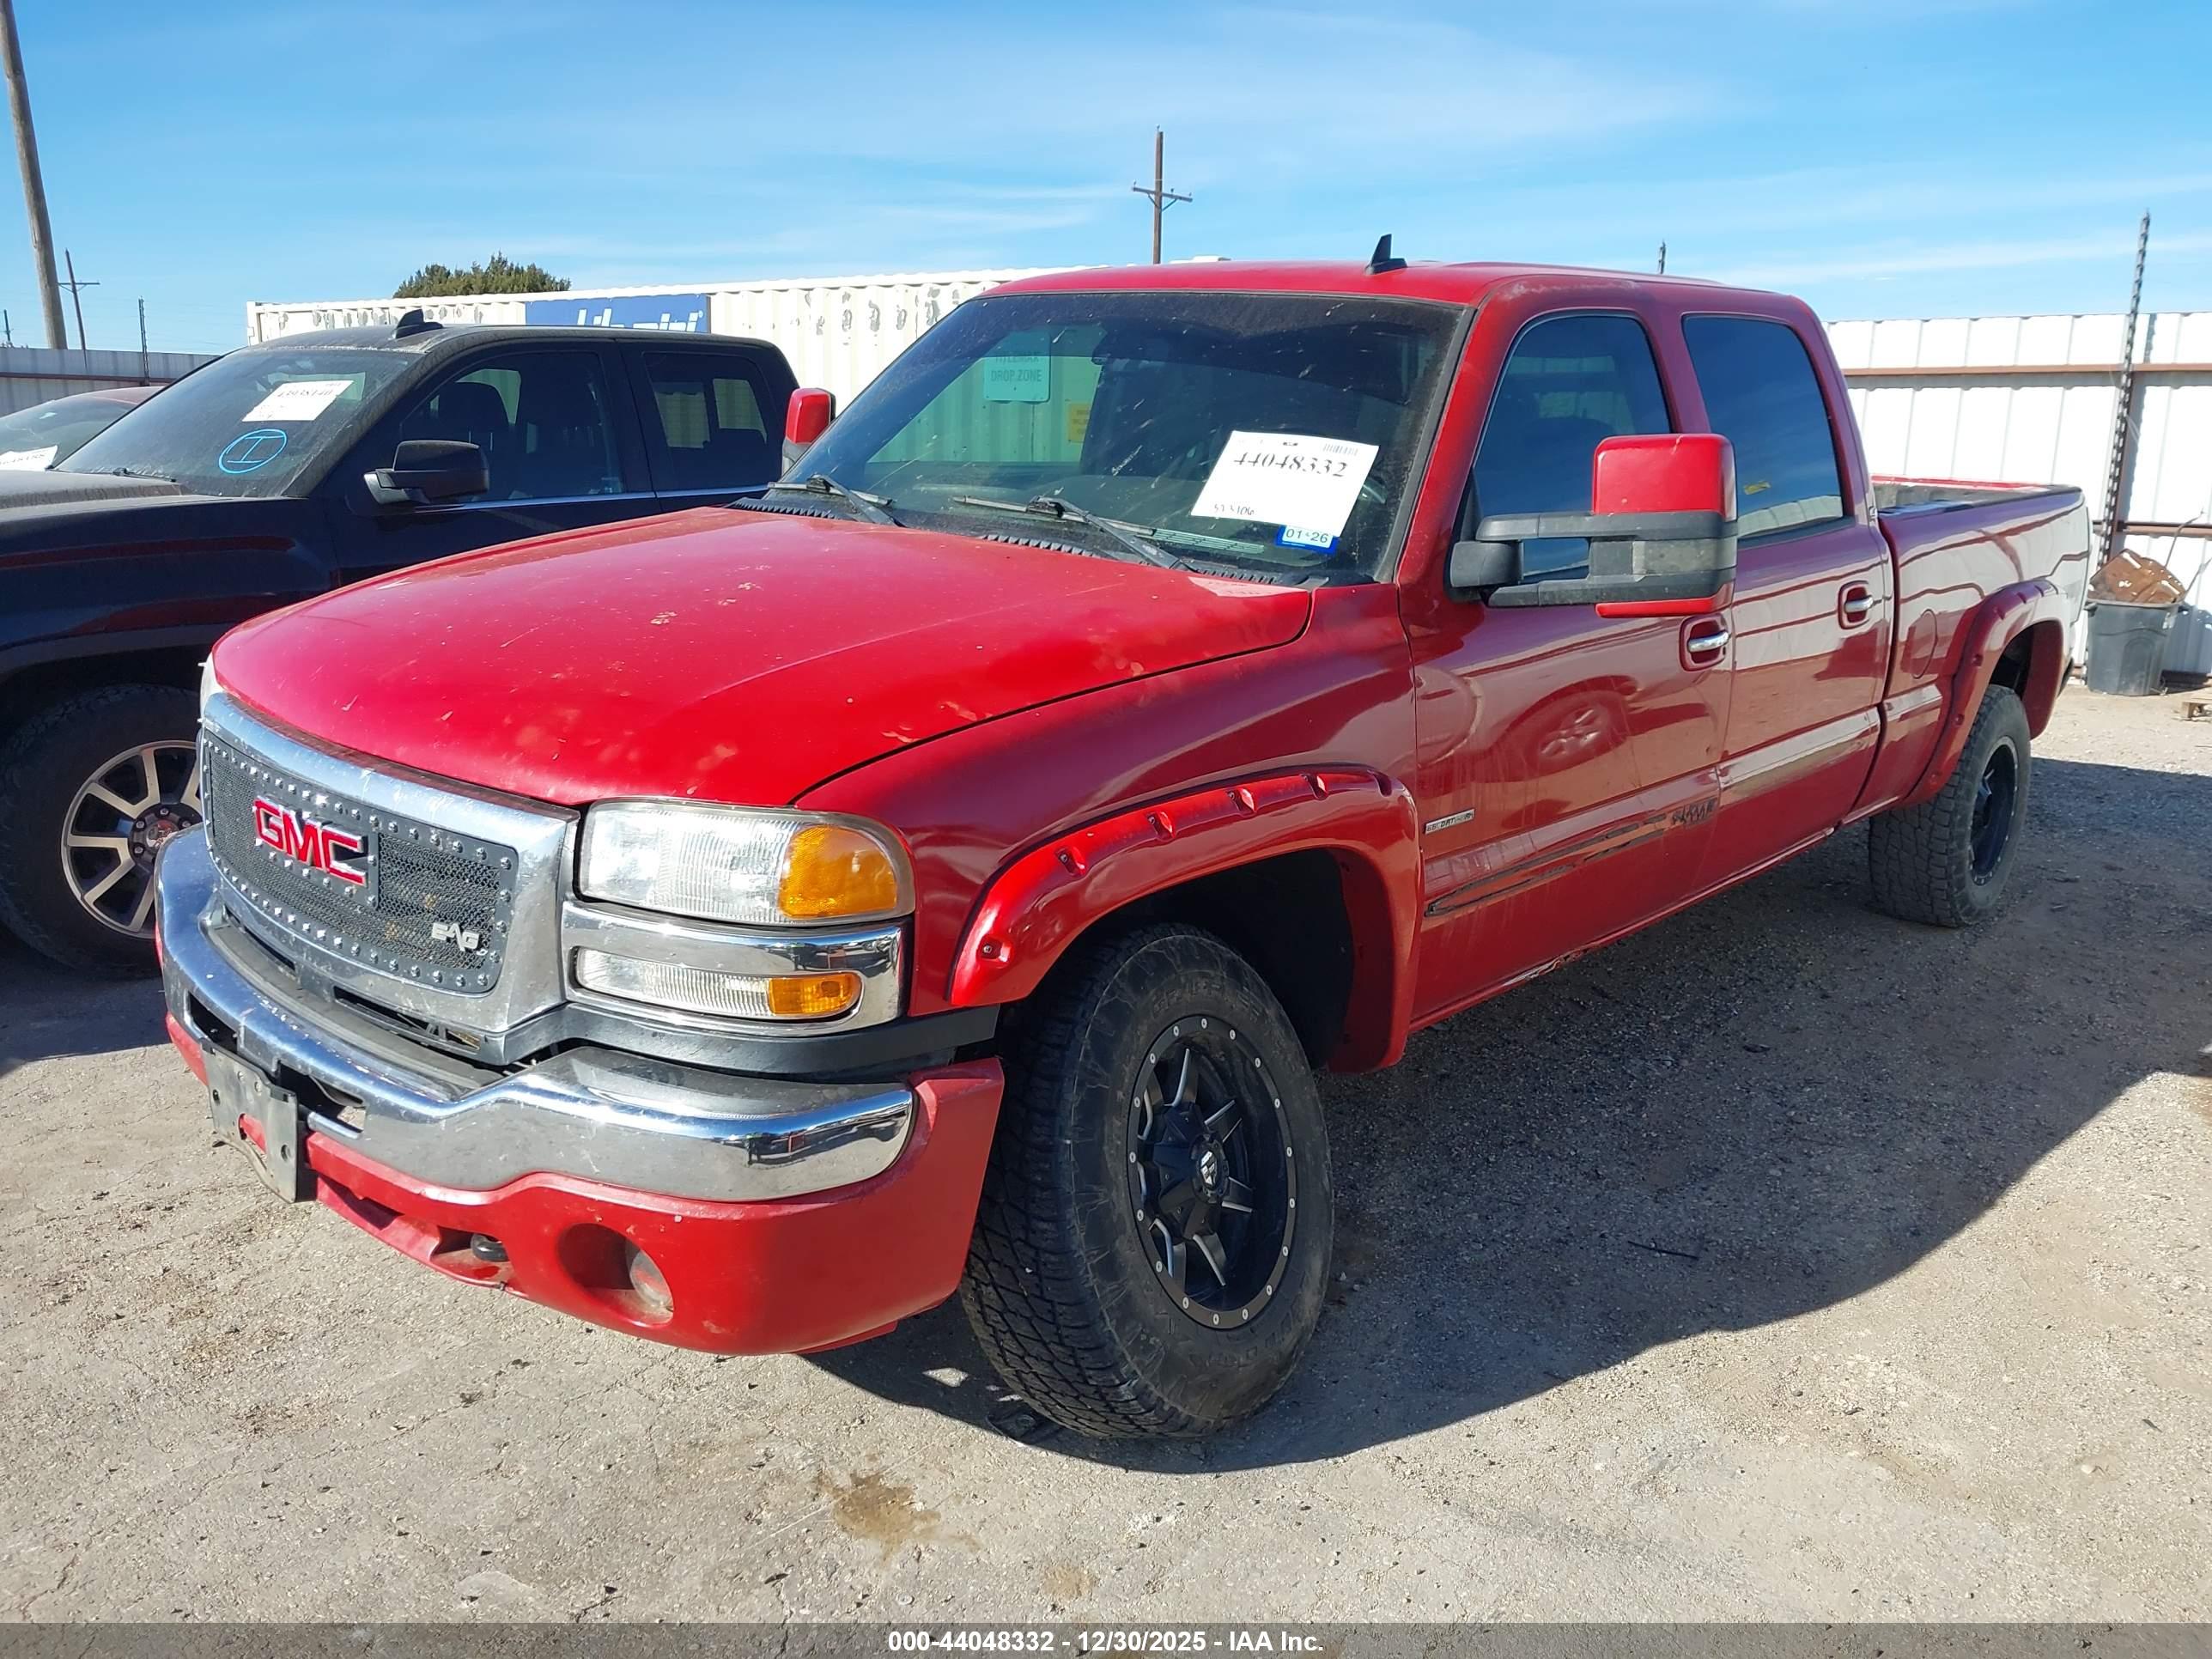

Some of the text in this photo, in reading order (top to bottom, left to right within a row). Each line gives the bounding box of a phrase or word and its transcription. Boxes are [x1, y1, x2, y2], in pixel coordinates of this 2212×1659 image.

[990, 368, 1042, 383] DROP ZONE
[1233, 452, 1348, 477] 44048332
[253, 795, 368, 886] GMC
